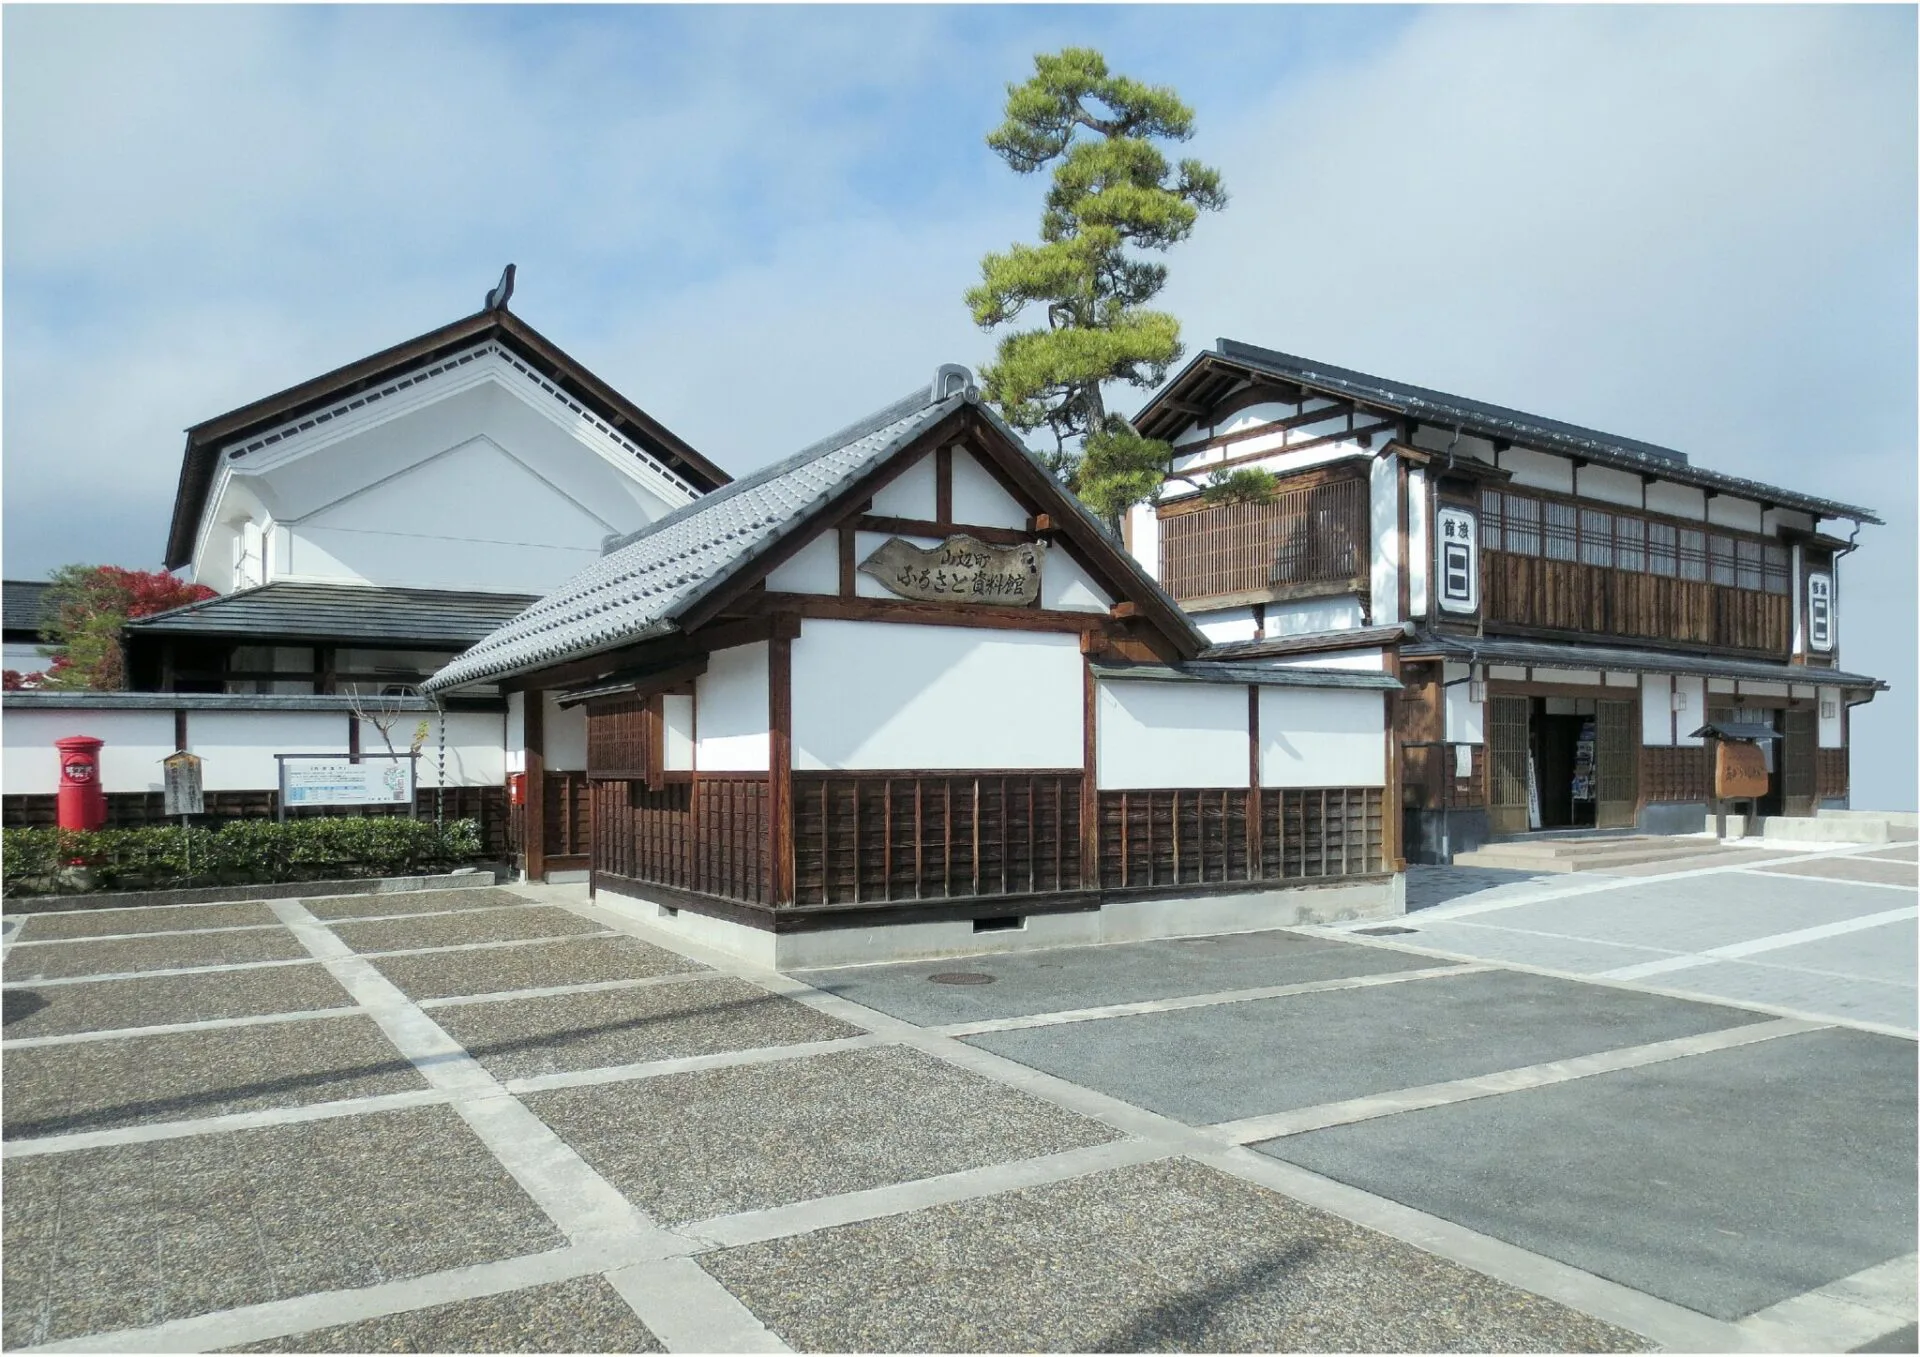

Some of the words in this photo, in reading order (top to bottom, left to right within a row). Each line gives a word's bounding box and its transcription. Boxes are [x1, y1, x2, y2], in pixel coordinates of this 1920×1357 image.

[940, 549, 991, 569] 山辺町
[896, 564, 1026, 596] ふるさと資料館
